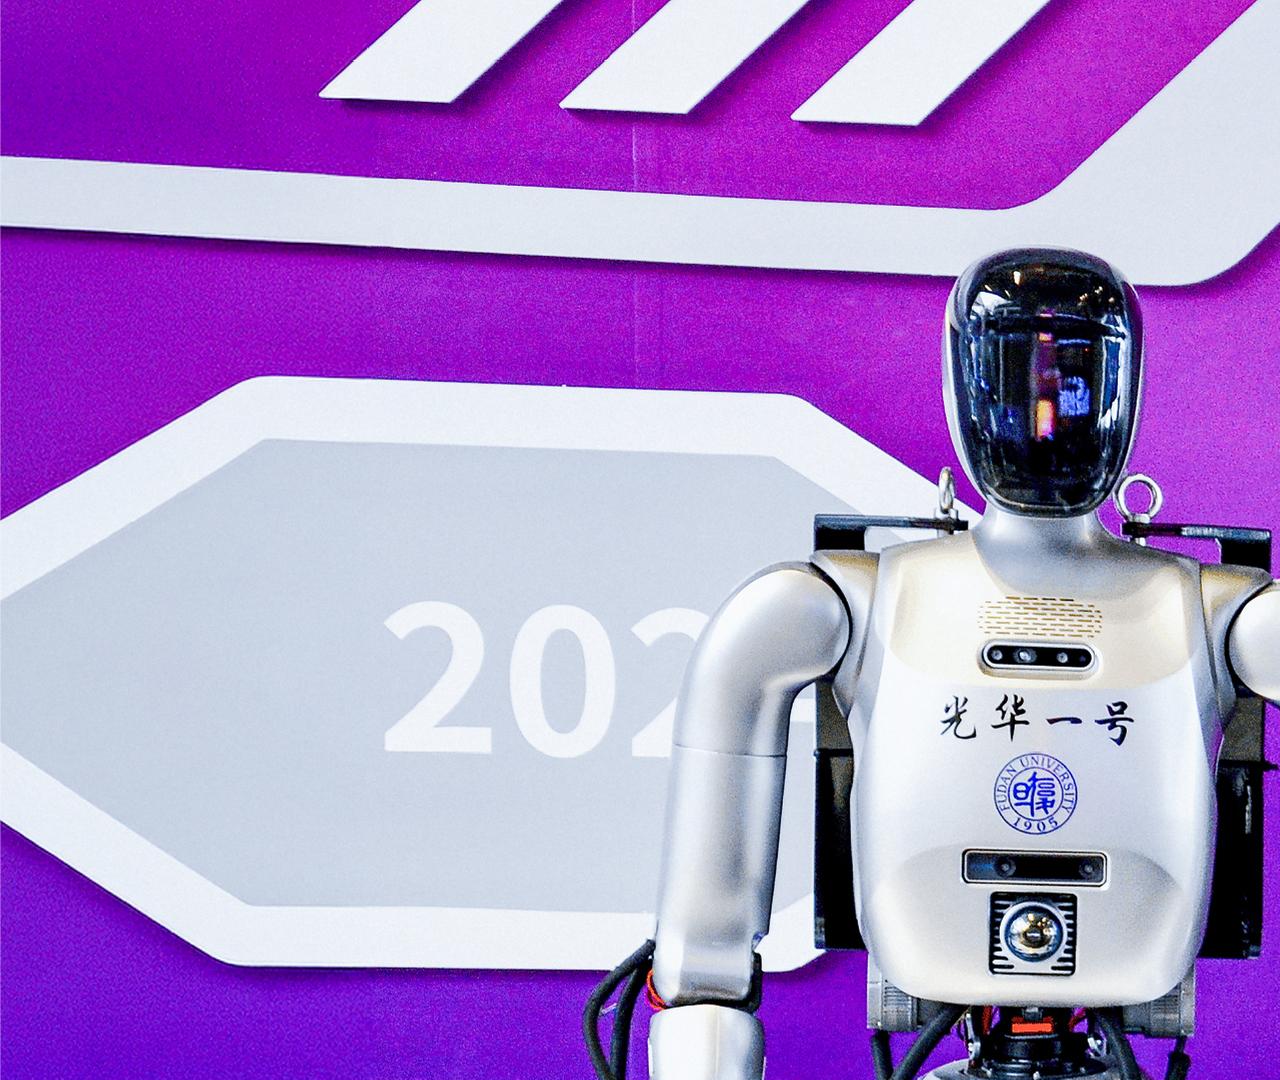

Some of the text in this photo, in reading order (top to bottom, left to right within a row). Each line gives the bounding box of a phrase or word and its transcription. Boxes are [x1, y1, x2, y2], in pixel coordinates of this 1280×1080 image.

[383, 600, 817, 758] 202
[940, 694, 1135, 747] 光华一号
[996, 755, 1075, 813] FUDAN UNIVERSITY
[1013, 816, 1059, 833] 1905
